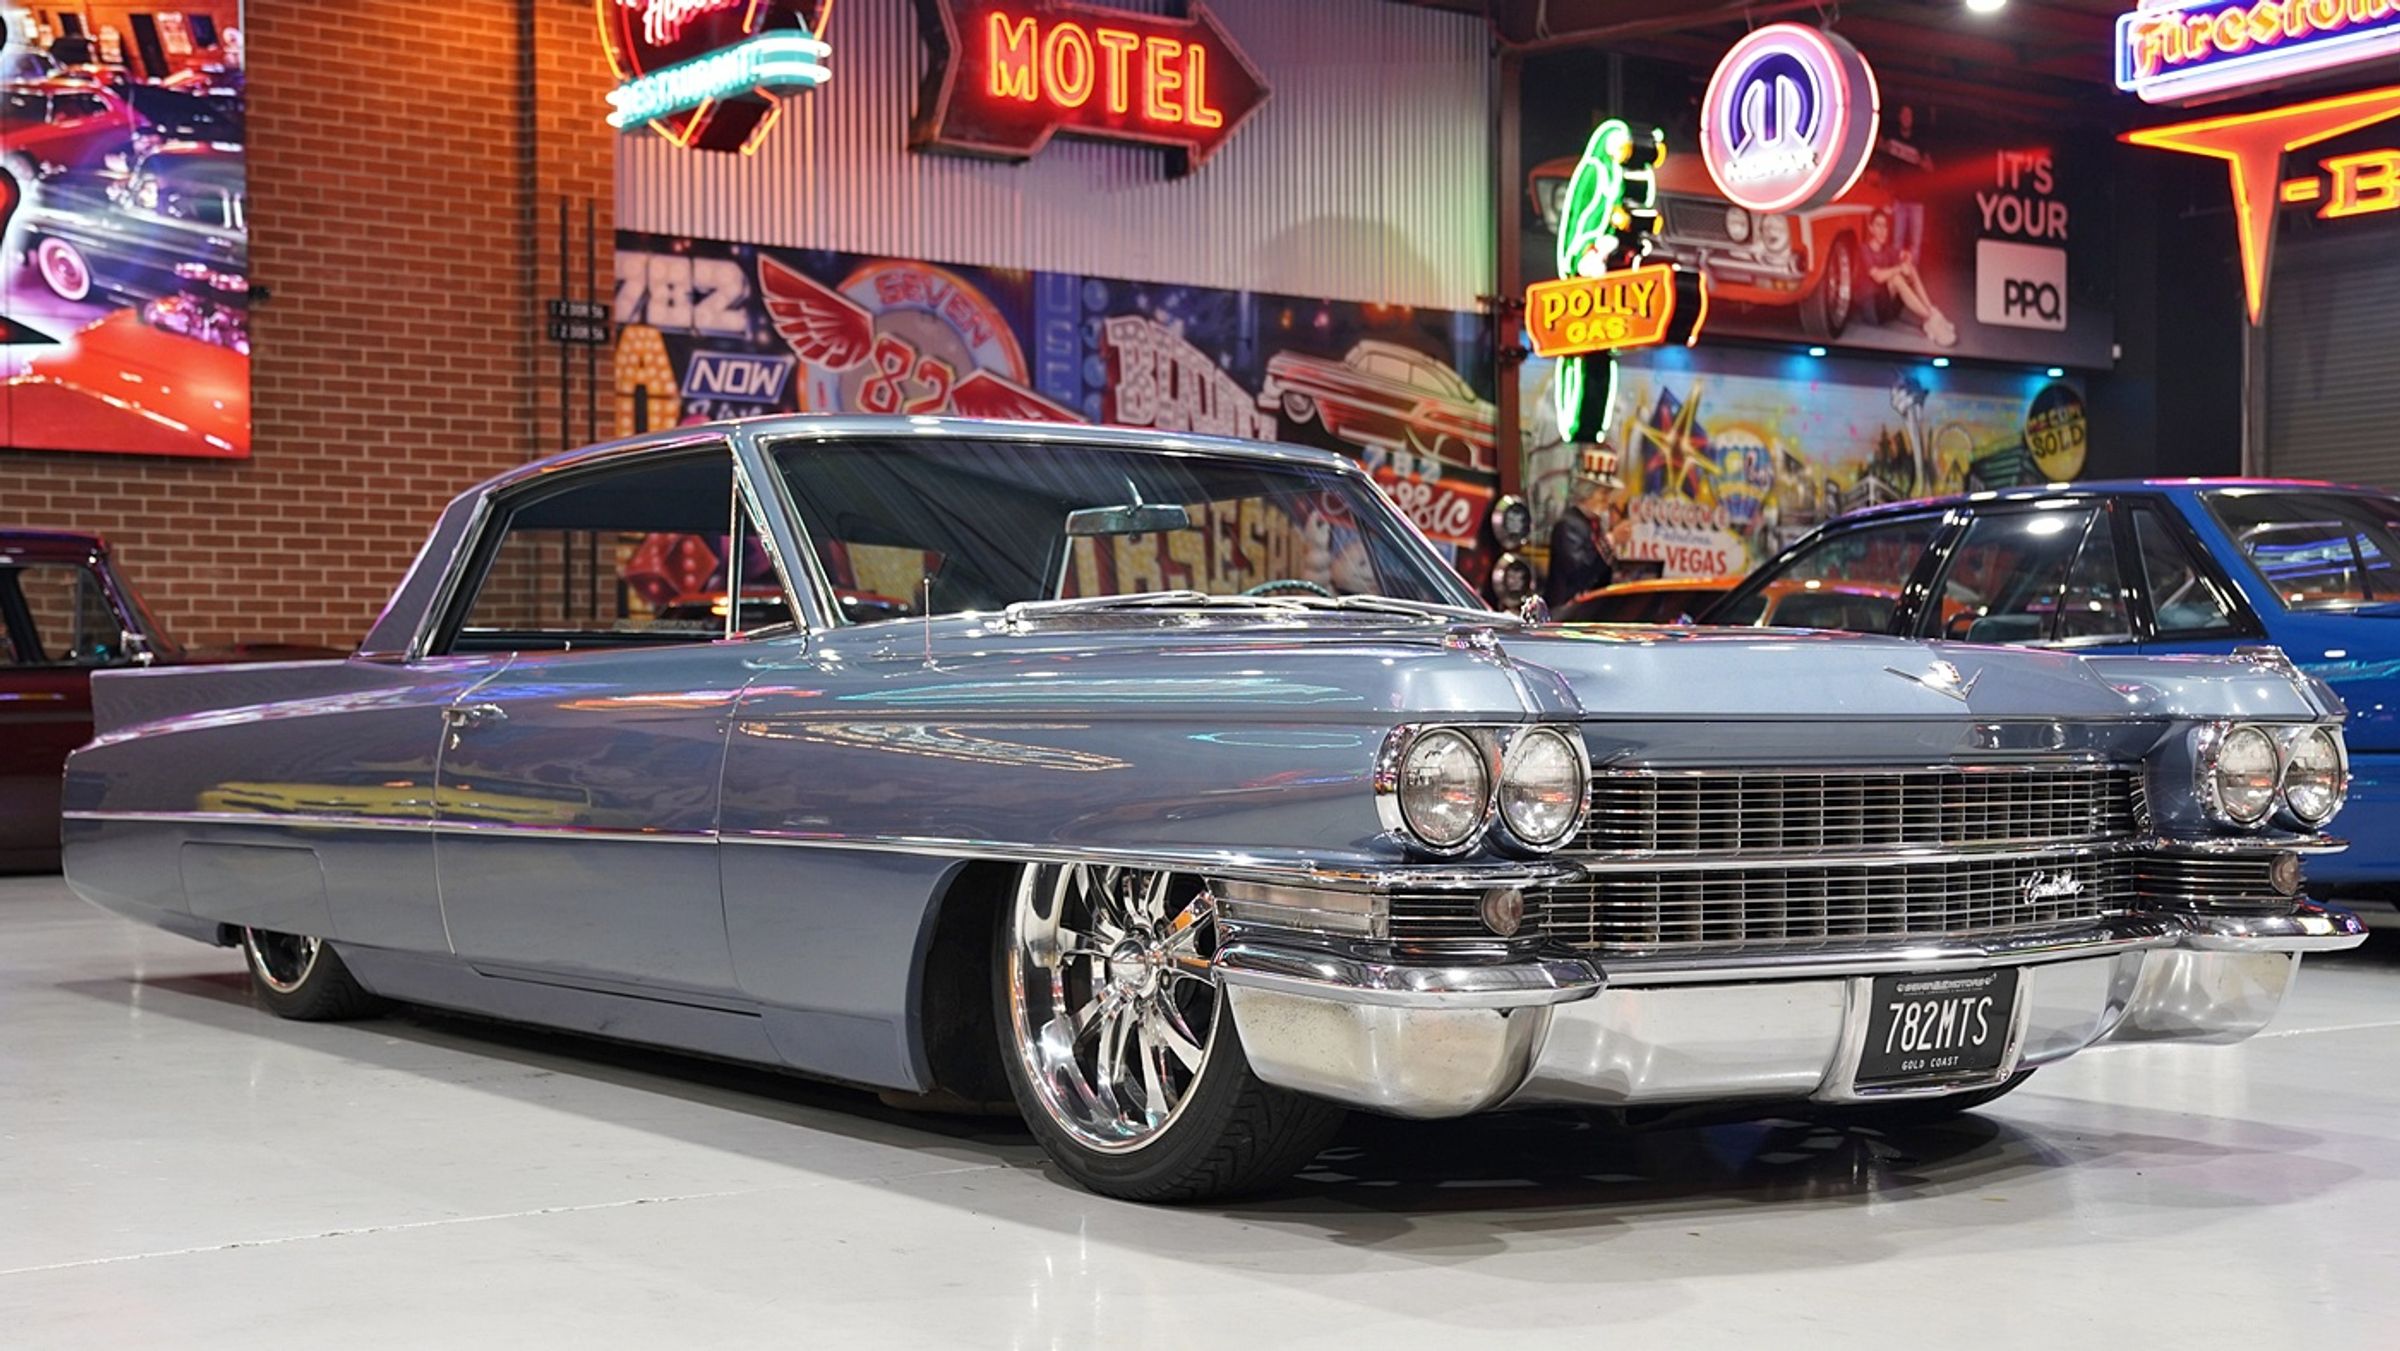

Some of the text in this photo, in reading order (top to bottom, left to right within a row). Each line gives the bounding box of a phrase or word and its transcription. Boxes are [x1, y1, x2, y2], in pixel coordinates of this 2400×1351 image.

[2127, 0, 2400, 79] Fireston
[988, 12, 1223, 128] MOTEL
[1997, 149, 2054, 194] IT'S
[1976, 190, 2068, 240] YOUR
[615, 250, 748, 335] 782
[874, 272, 993, 348] SEVEN
[1541, 279, 1655, 330] POLLY
[2004, 278, 2062, 323] PPQ
[1566, 317, 1626, 343] GAS
[690, 358, 783, 398] NOW
[856, 332, 954, 415] 82
[2031, 425, 2084, 459] SOLD
[1666, 545, 1728, 576] VEGAS
[1884, 995, 1993, 1054] 782MTS
[1901, 1055, 1960, 1071] GOLD COAST
